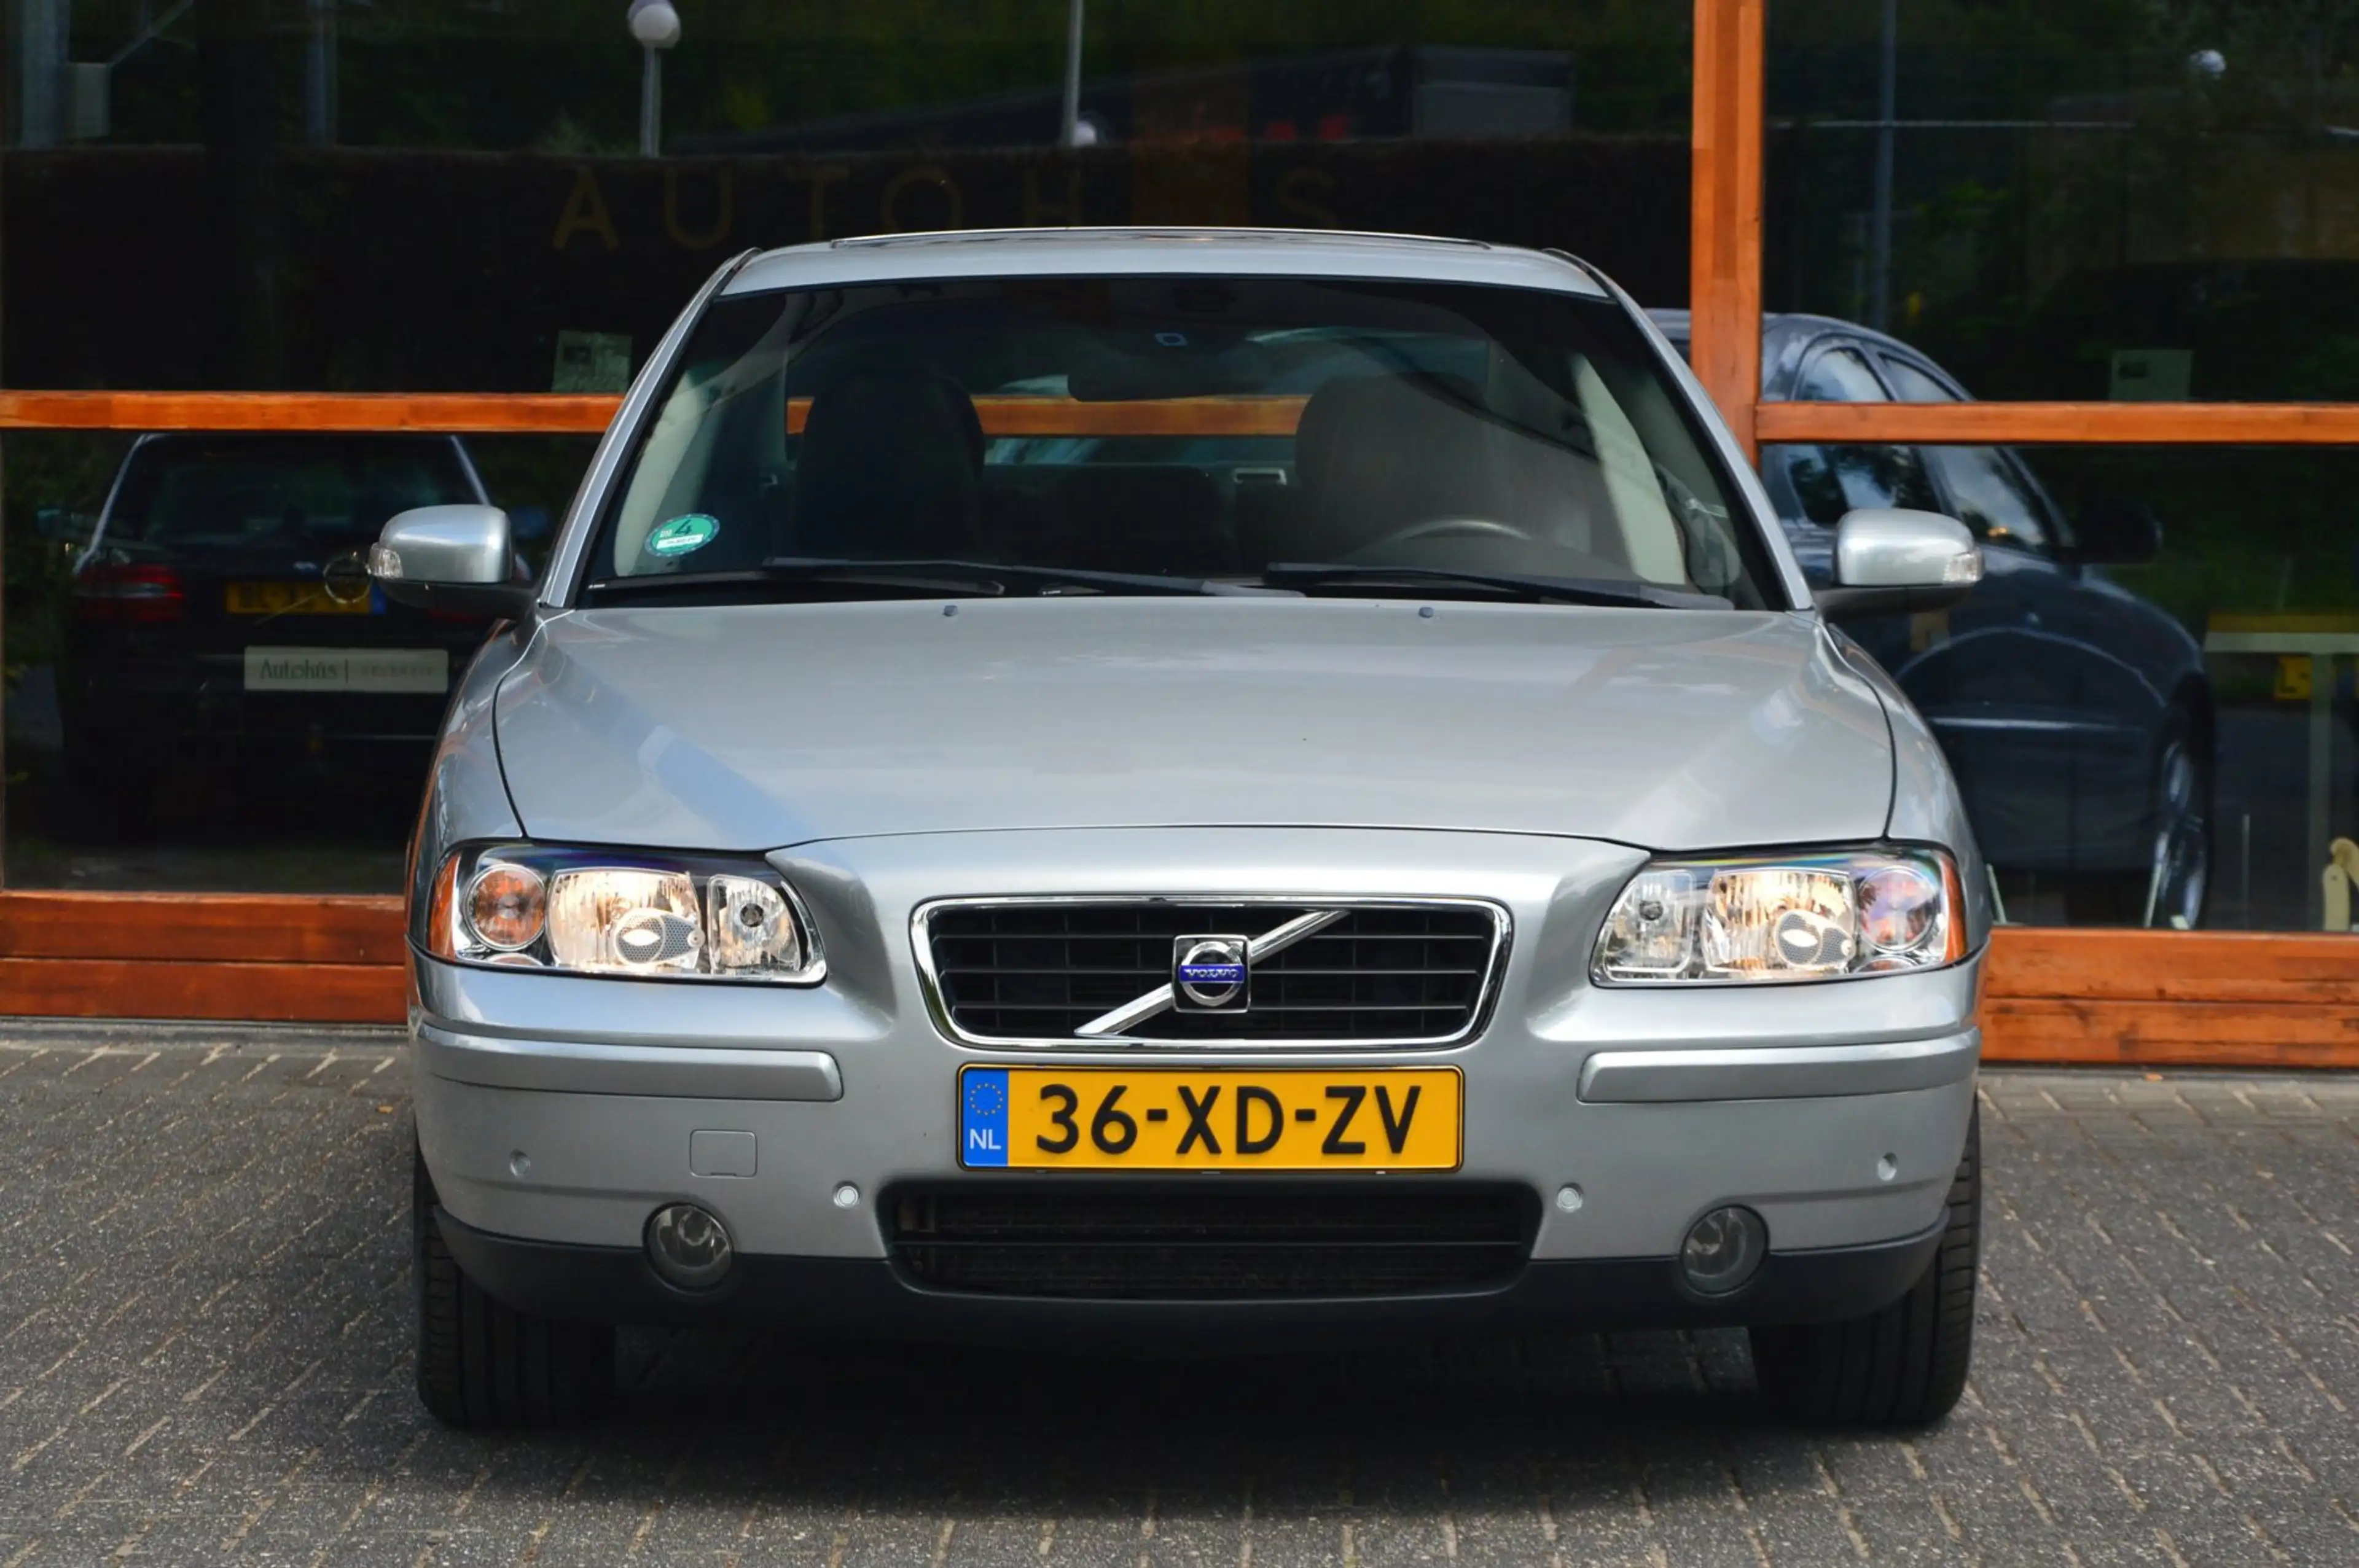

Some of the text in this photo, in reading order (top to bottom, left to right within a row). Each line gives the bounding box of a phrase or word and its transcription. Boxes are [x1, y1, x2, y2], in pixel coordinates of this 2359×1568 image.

[553, 165, 1339, 251] AUTOHS
[674, 519, 692, 534] 4
[1184, 968, 1239, 978] VOLVO
[1036, 1084, 1422, 1155] 36-XD-ZV
[969, 1129, 1001, 1150] NL
